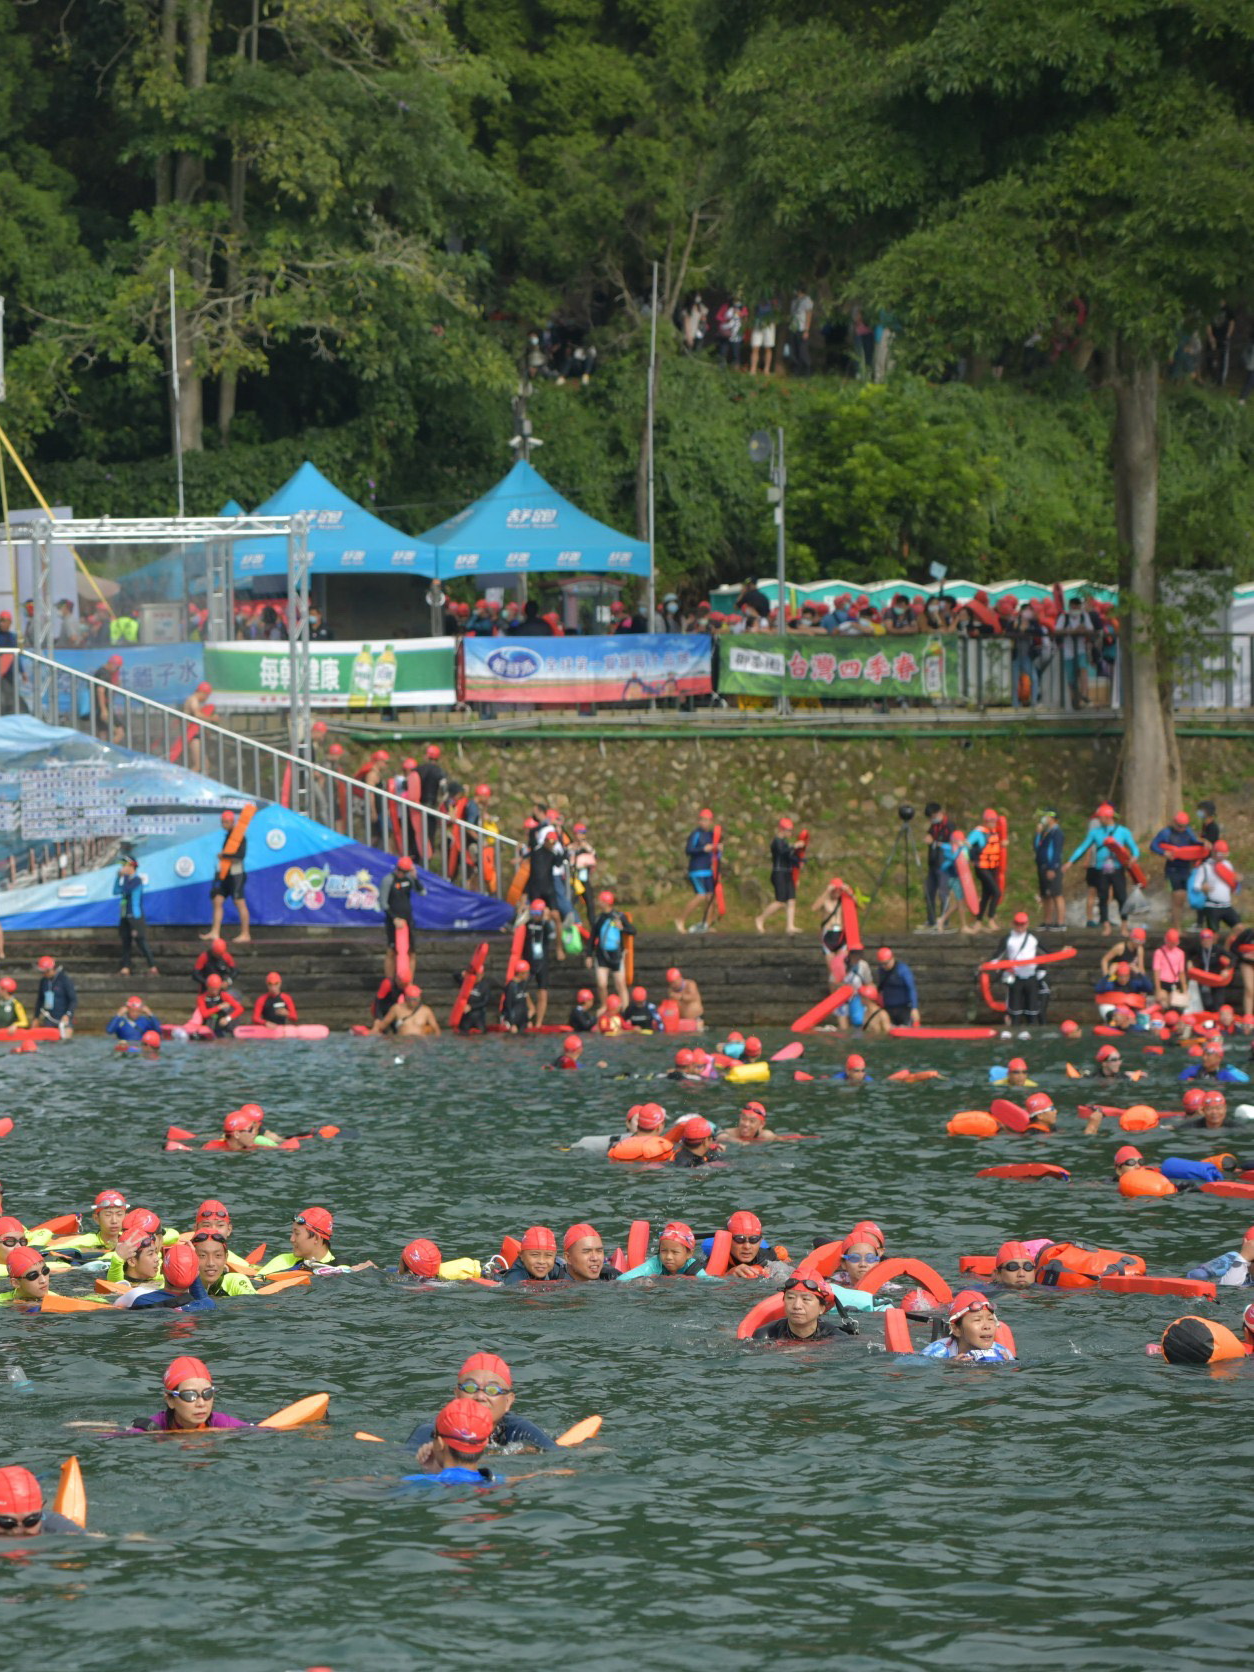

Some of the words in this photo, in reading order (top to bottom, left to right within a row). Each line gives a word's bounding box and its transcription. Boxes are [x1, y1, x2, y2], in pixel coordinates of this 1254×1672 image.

[507, 508, 557, 523] 舒跑
[788, 651, 919, 684] 台灣四季春
